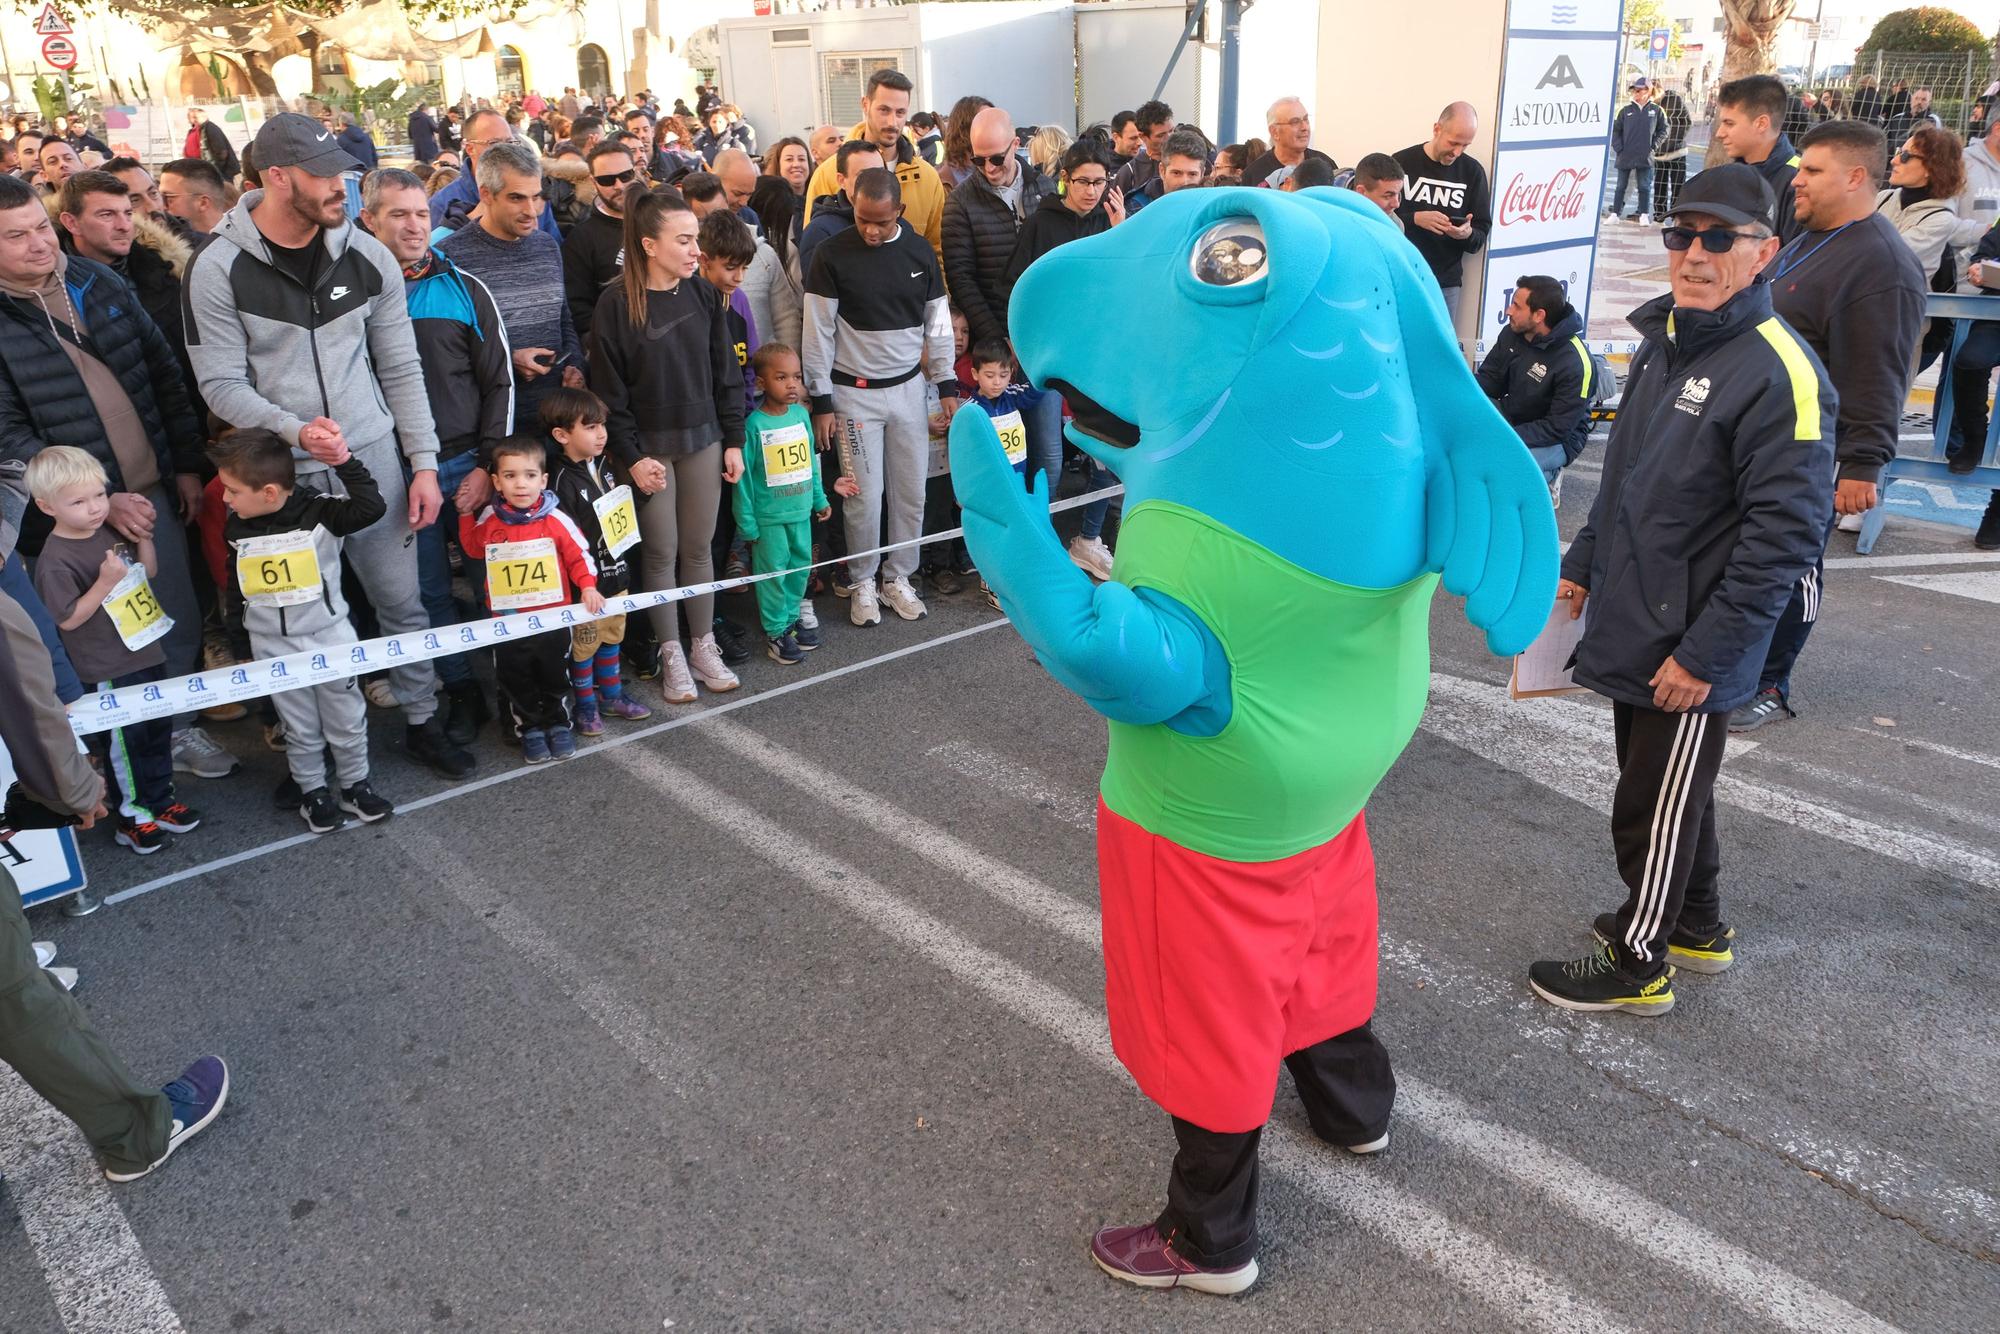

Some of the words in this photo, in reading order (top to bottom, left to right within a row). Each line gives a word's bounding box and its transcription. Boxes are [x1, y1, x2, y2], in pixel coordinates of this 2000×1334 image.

[1509, 101, 1601, 127] ASTONDOA
[1403, 174, 1468, 209] VANS
[1500, 167, 1592, 226] Coca-Cola
[847, 418, 860, 456] SQUAD
[777, 442, 807, 467] 150
[608, 507, 628, 537] 135
[261, 558, 292, 585] 61
[502, 561, 547, 587] 174
[1640, 975, 1668, 998] HOKA
